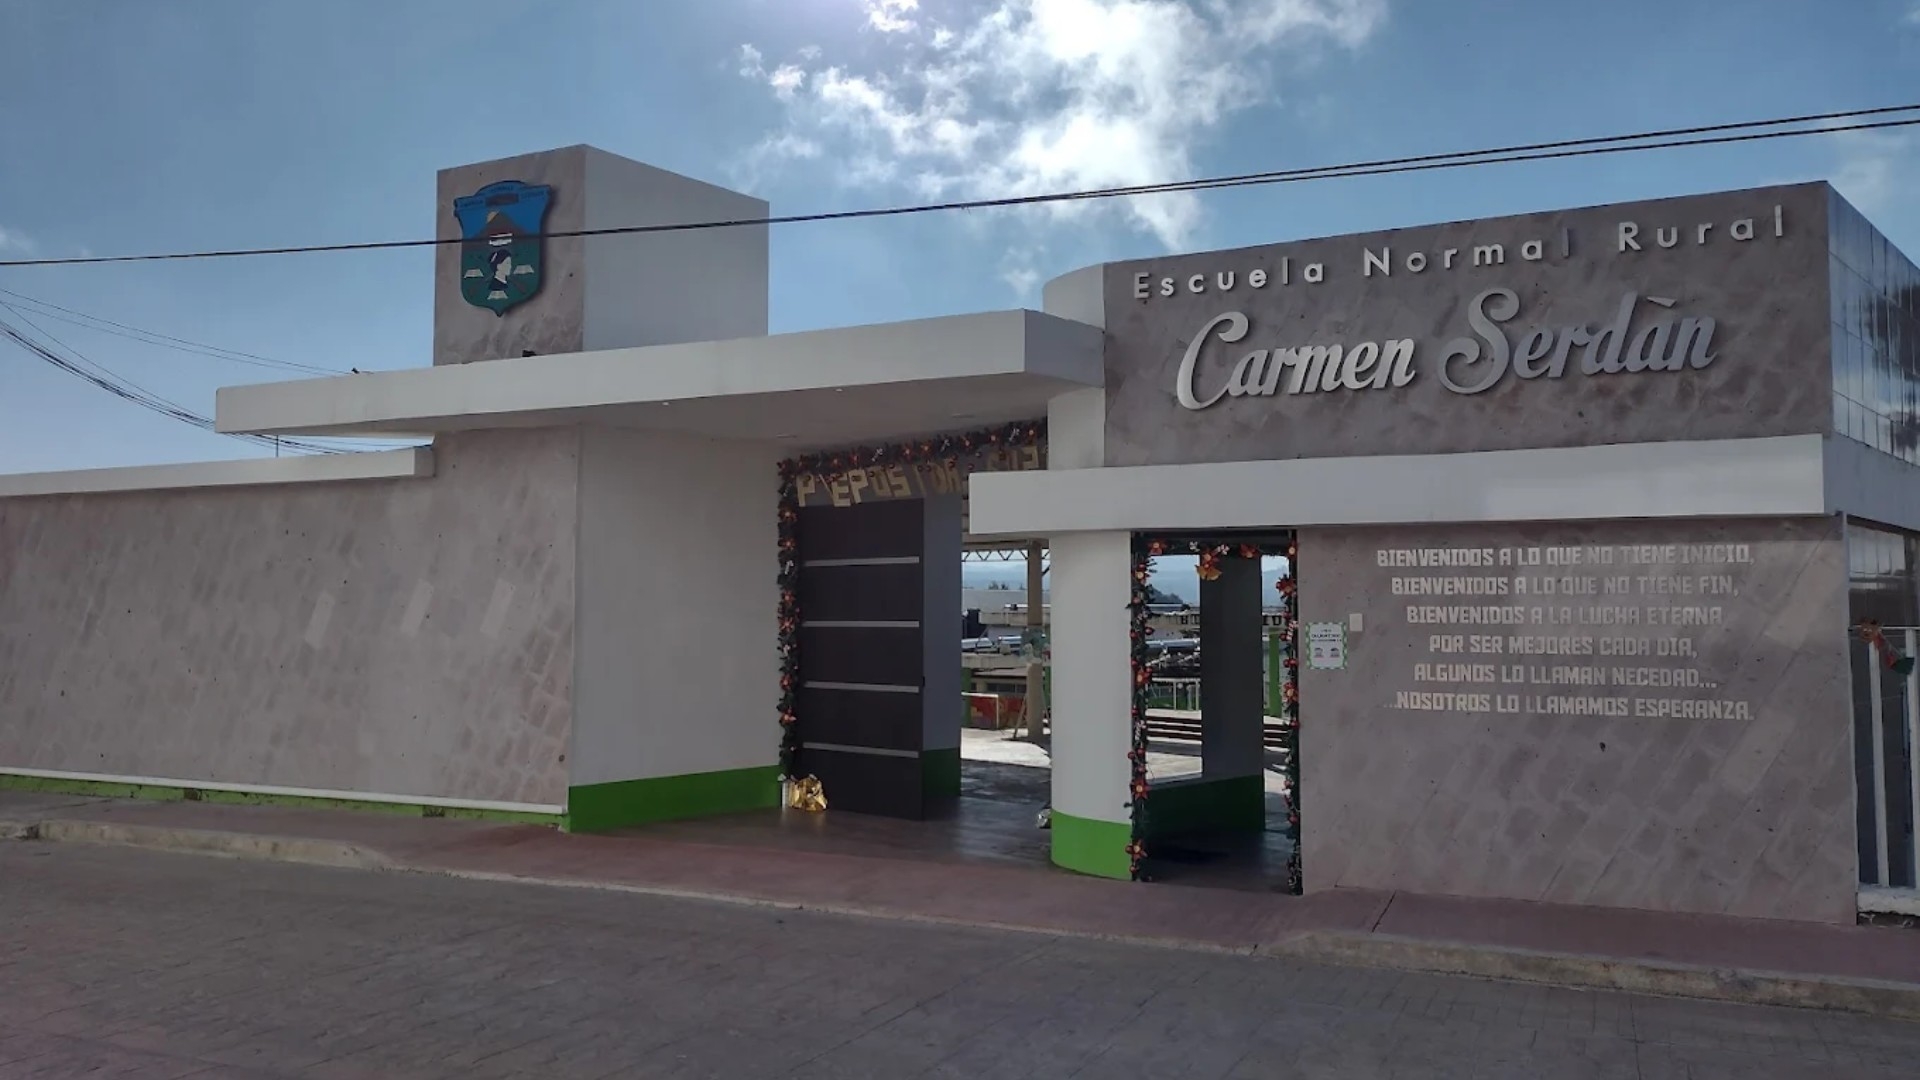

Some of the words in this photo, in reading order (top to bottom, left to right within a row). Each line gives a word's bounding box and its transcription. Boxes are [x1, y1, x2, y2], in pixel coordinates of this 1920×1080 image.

[1133, 257, 1325, 300] Escuela
[1363, 225, 1571, 277] Normal
[1617, 205, 1784, 252] Rural
[1176, 310, 1416, 411] Carmen
[1377, 548, 1493, 567] BIENVENIDOS
[1499, 548, 1511, 567] A
[1517, 547, 1540, 566] LO
[1546, 548, 1582, 567] QUE
[1587, 547, 1613, 565] NO
[1620, 546, 1676, 565] TIENE
[1681, 545, 1755, 566] INICIO,
[1391, 576, 1508, 595] BIENVENIDOS
[1514, 576, 1527, 594] A
[1532, 576, 1556, 595] LO
[1562, 577, 1597, 596] QUE
[1604, 576, 1630, 595] NO
[1637, 575, 1693, 595] TIENE
[1699, 575, 1739, 597] FIN,
[1406, 606, 1525, 625] BIENVENIDOS
[1530, 606, 1543, 624] A
[1549, 606, 1572, 624] LA
[1578, 606, 1640, 625] LUCHA
[1646, 606, 1723, 626] ETERNA
[1429, 635, 1464, 653] POR
[1470, 635, 1503, 654] SER
[1508, 636, 1593, 656] MEJORES
[1599, 637, 1650, 656] CADA
[1414, 664, 1496, 683] ALGUNOS
[1501, 665, 1525, 683] LO
[1530, 665, 1606, 686] LLAMAN
[1611, 667, 1718, 689] NECEDAD...
[1496, 694, 1520, 713] LO
[1525, 695, 1629, 717] LLAMAMOS
[1635, 698, 1754, 720] ESPERANZA.
